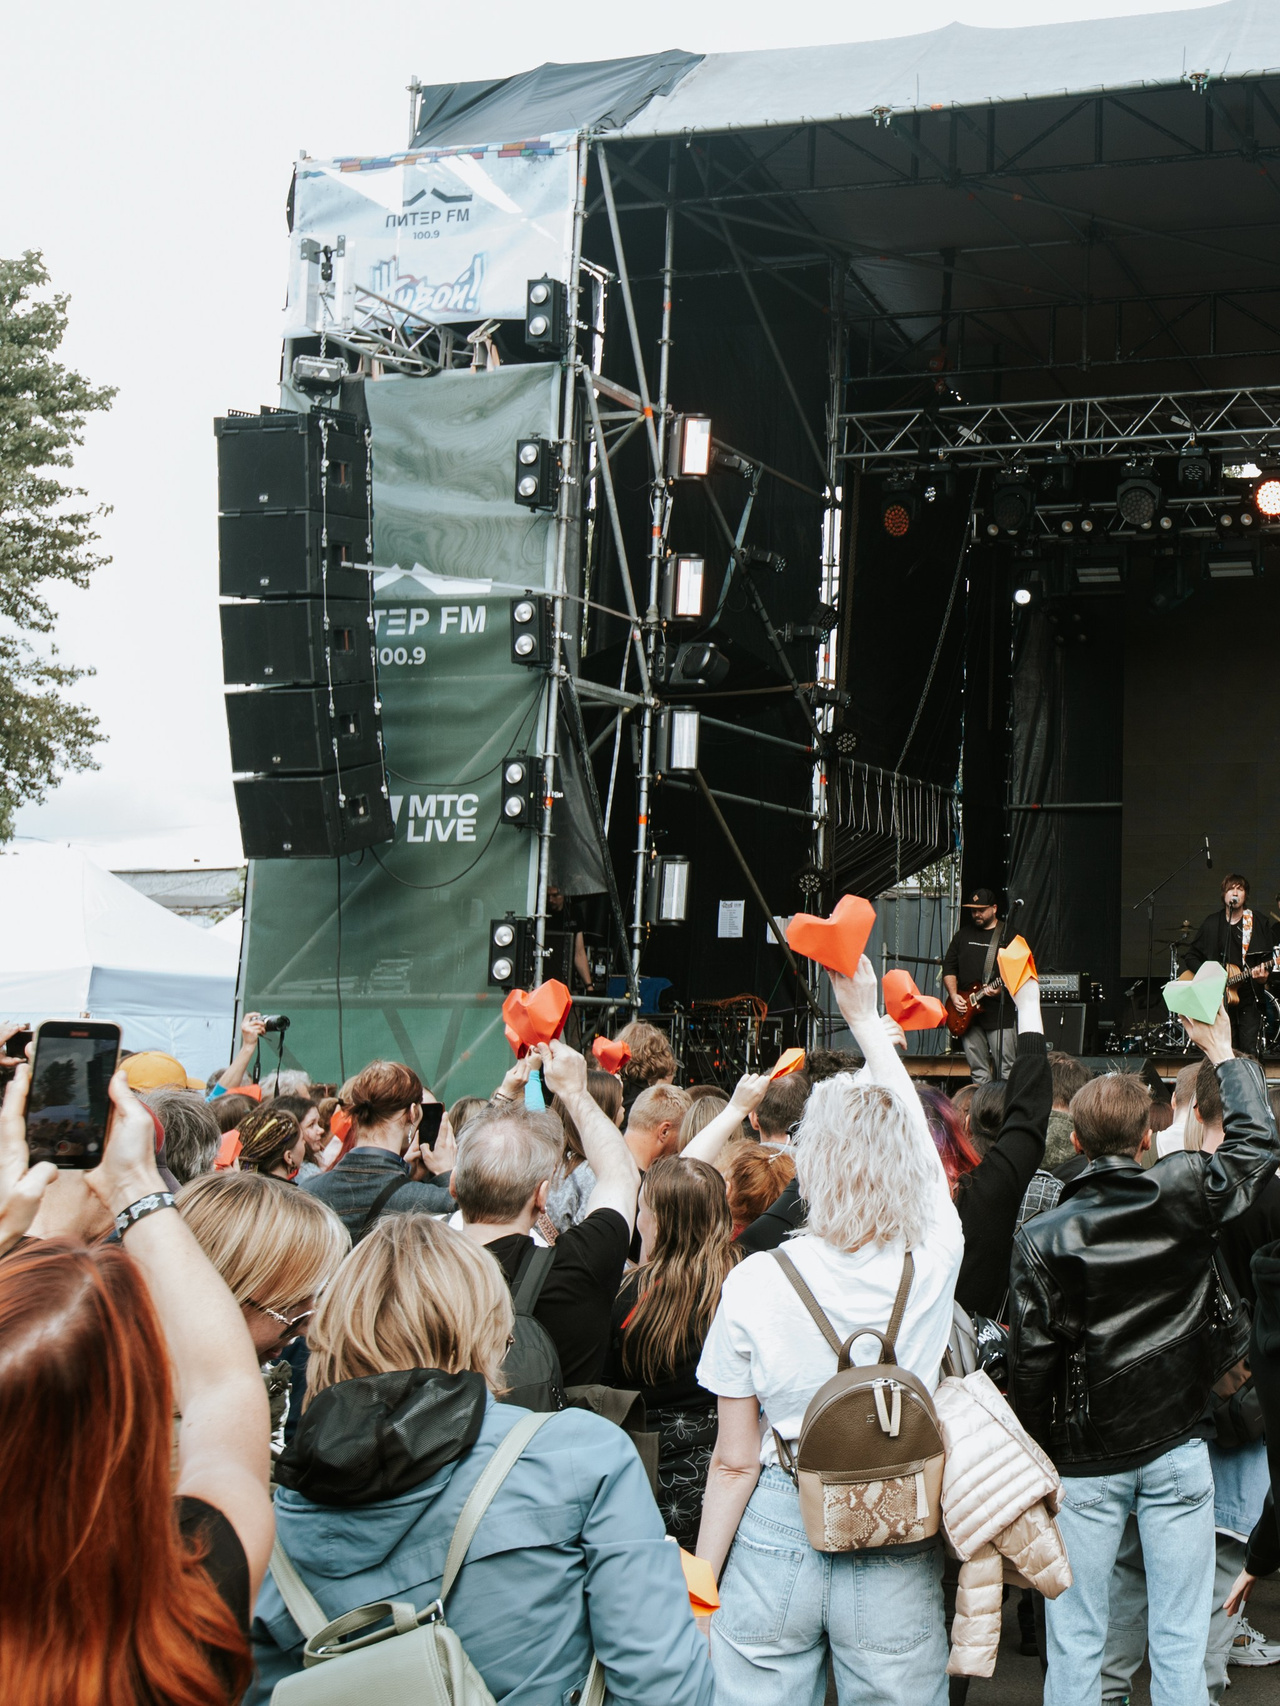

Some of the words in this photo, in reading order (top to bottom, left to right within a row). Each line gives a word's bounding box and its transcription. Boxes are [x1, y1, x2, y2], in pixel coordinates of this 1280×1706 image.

[385, 211, 442, 228] ПИТЕР
[446, 208, 470, 223] FM
[413, 230, 440, 240] 100.9
[374, 607, 430, 636] ТЕР
[439, 605, 487, 635] FM
[408, 793, 480, 818] МТС
[406, 818, 477, 843] LIVE
